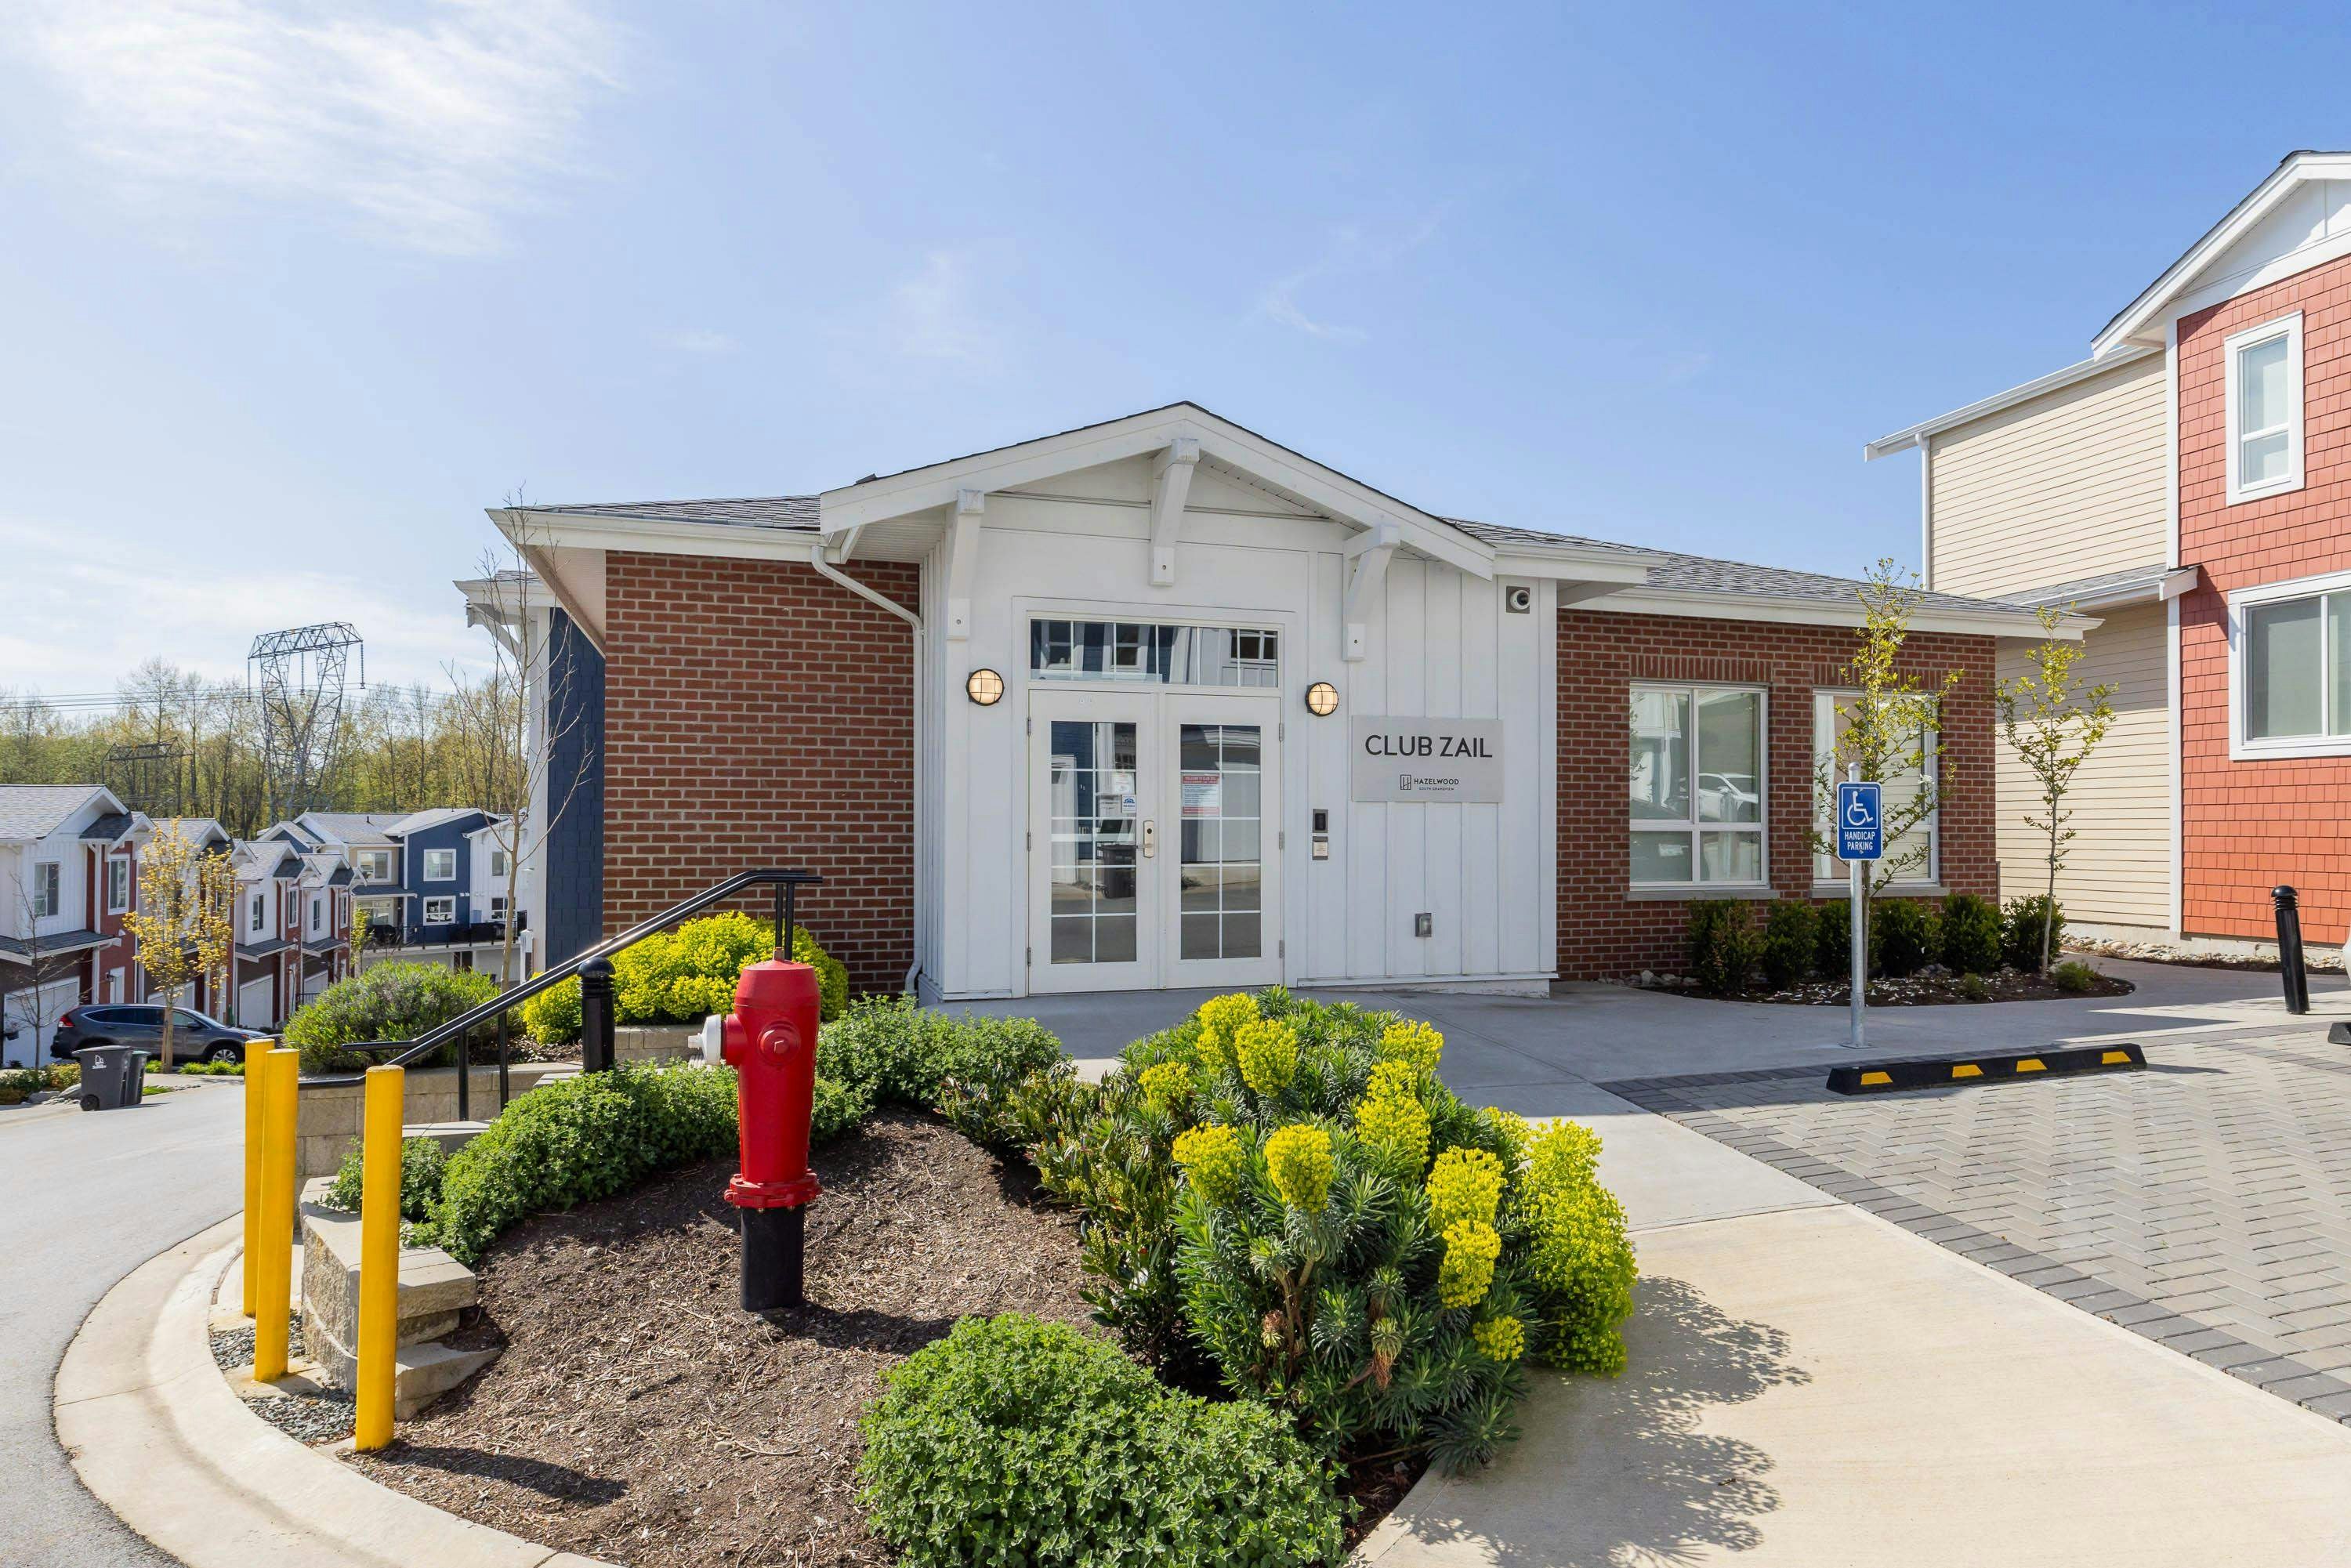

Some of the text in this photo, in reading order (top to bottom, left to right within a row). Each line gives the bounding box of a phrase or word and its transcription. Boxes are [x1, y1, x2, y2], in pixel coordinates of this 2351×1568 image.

[1365, 734, 1493, 758] CLUB ZAIL
[1844, 831, 1875, 840] HANDICAP
[1847, 841, 1873, 850] PARKING
